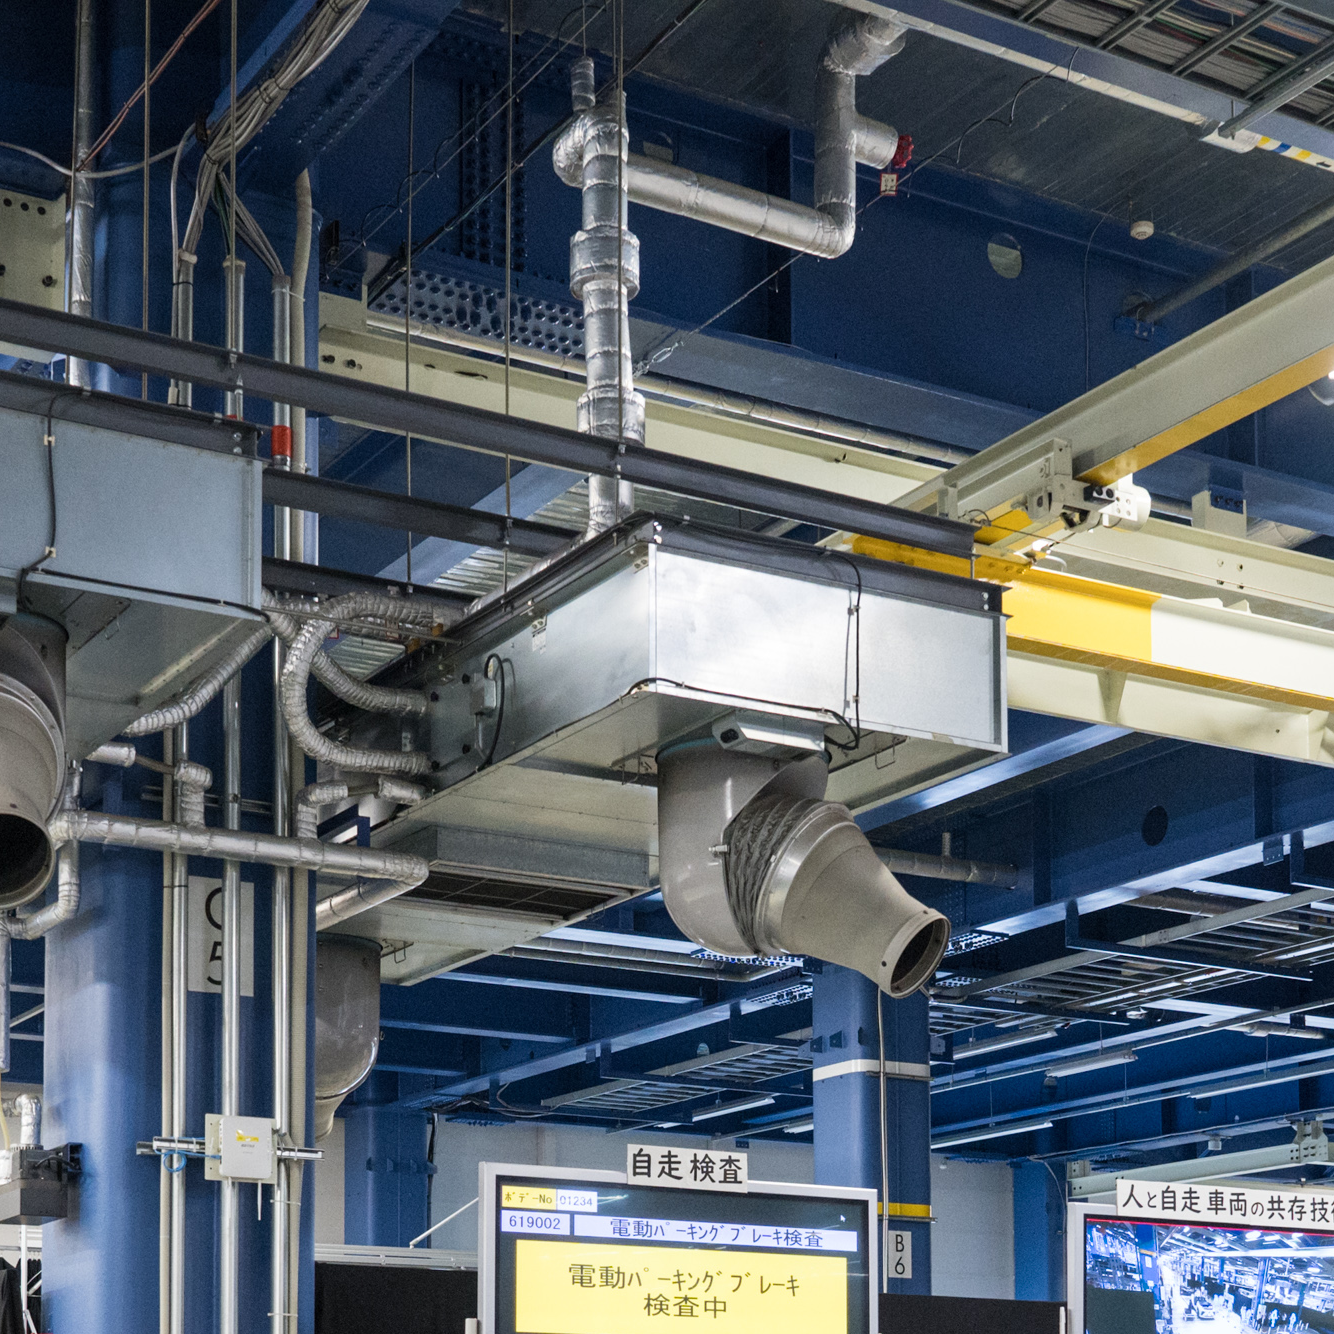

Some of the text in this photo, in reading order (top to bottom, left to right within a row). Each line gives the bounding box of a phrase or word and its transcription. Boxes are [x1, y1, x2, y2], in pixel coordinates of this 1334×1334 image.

[631, 1148, 744, 1185] 自走検査
[559, 1195, 593, 1206] 01234
[509, 1215, 561, 1230] 619002
[643, 1293, 728, 1319] 検査中
